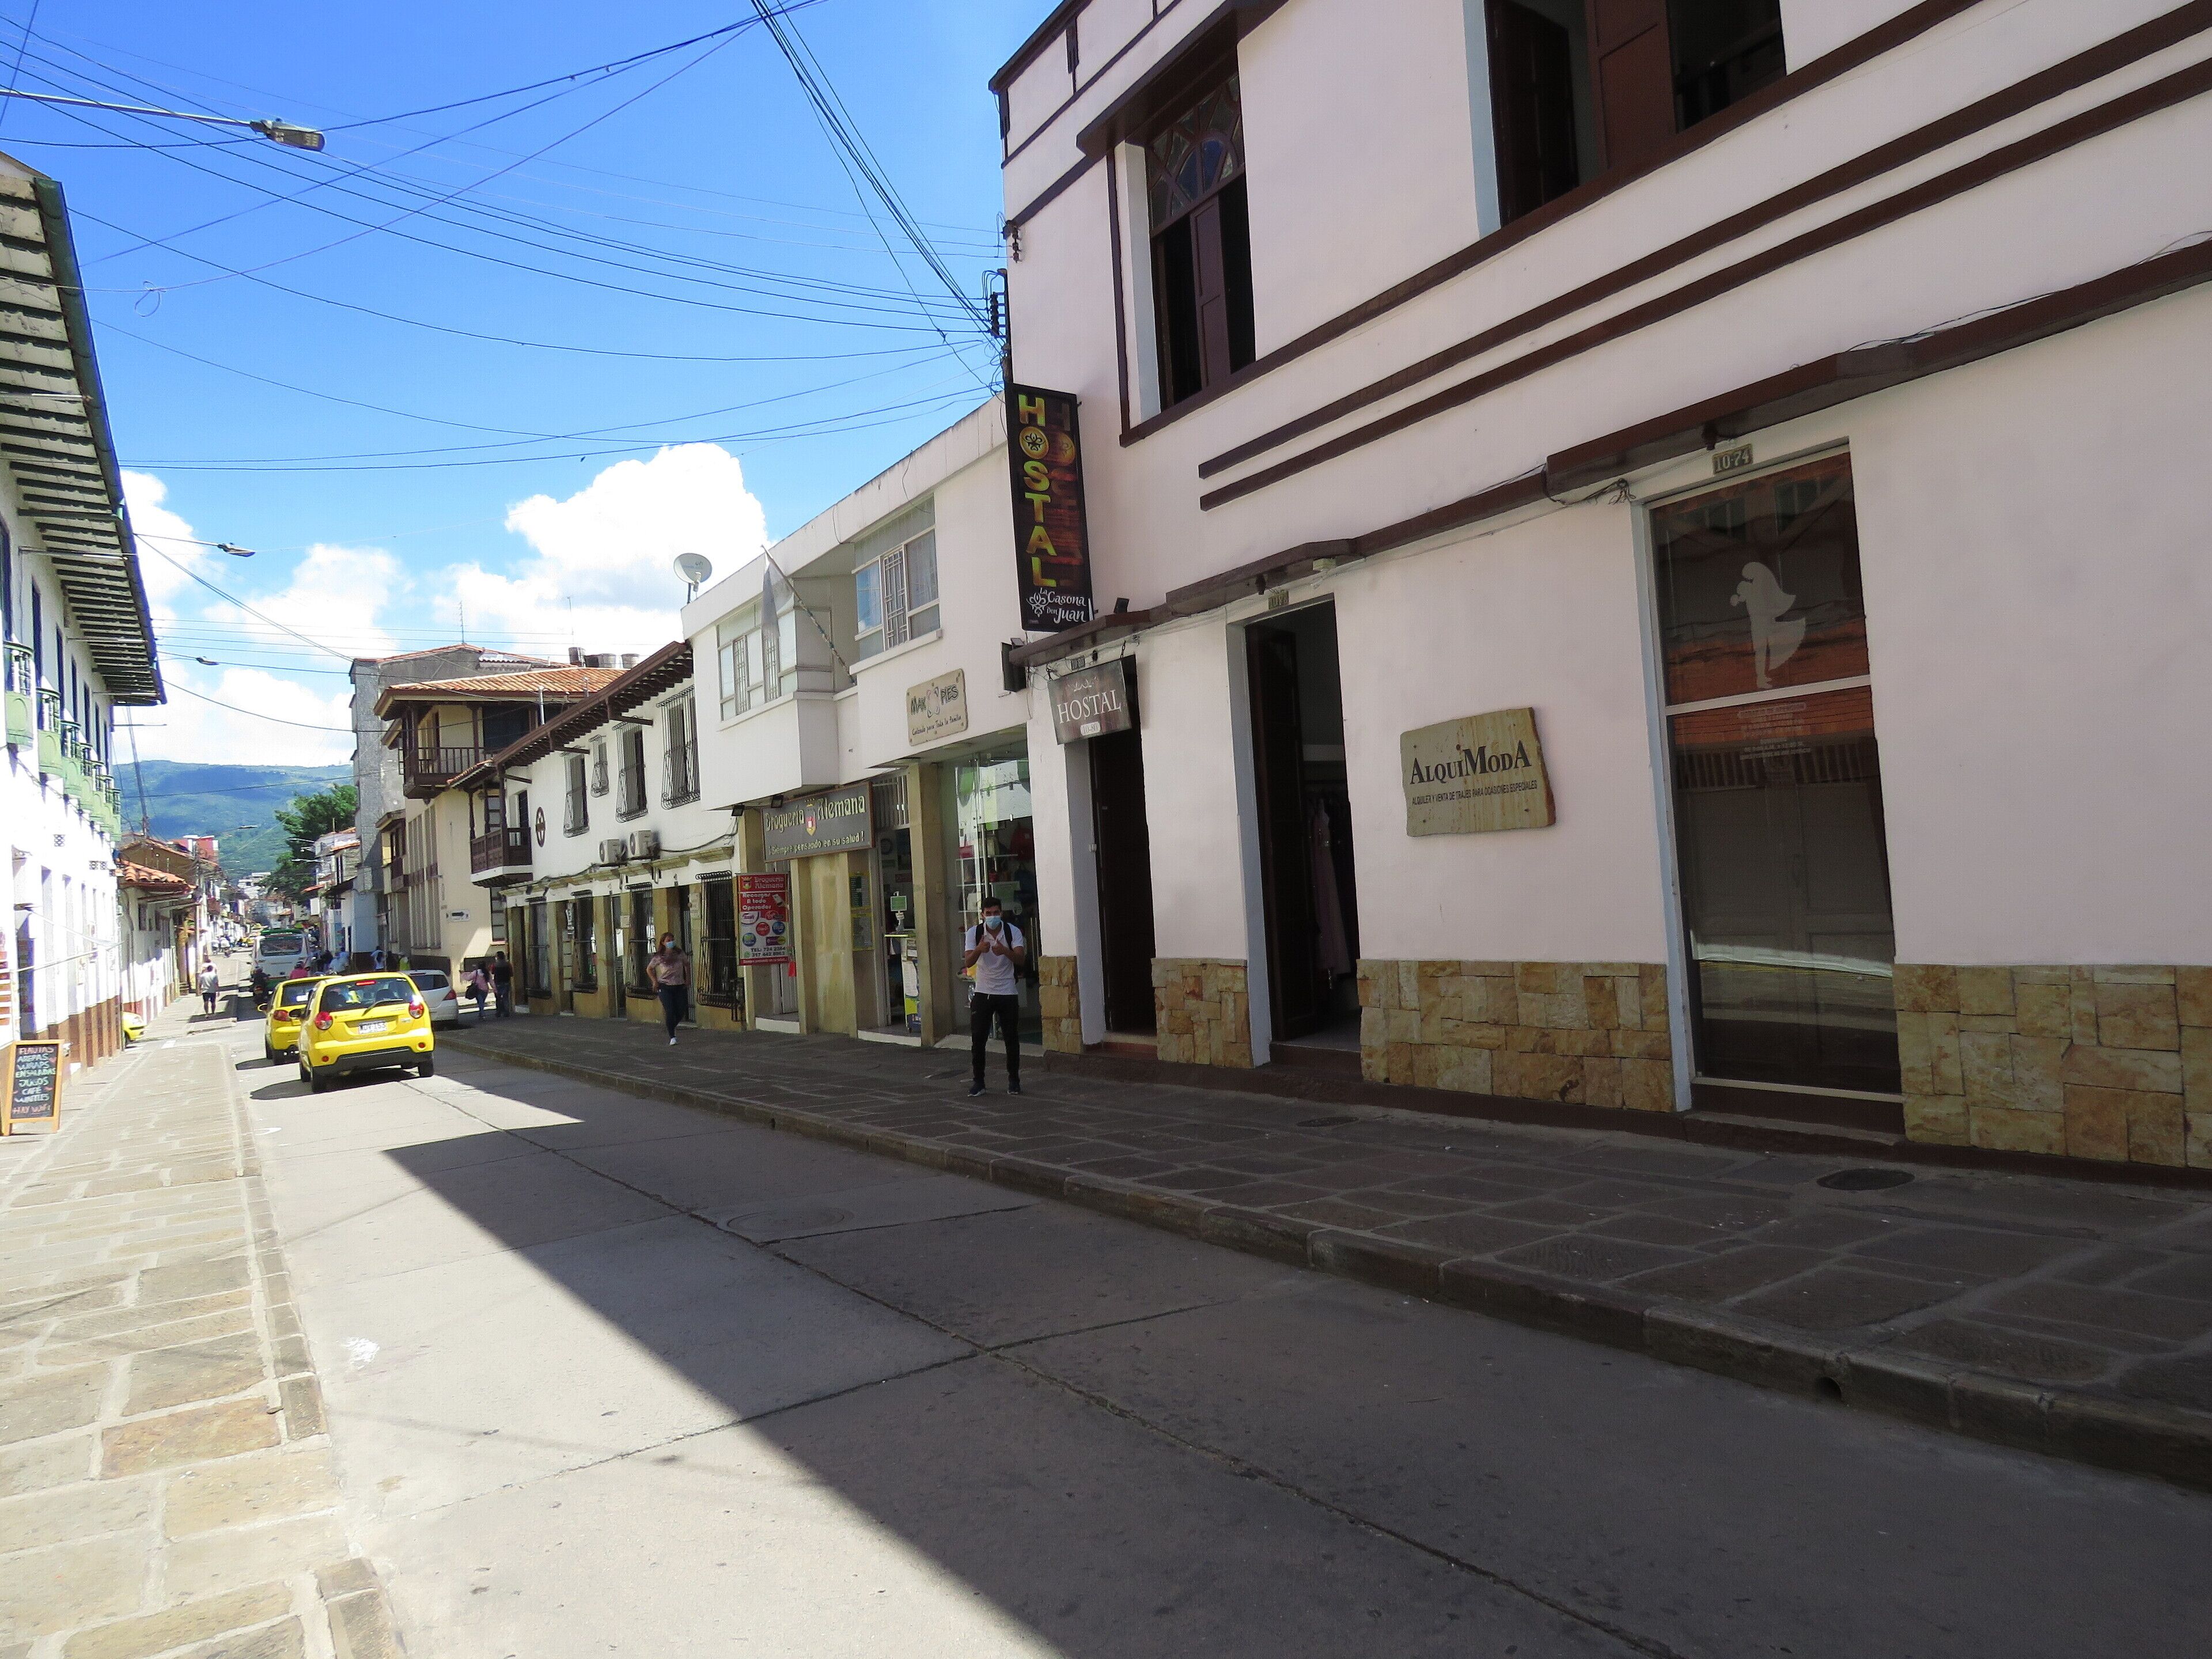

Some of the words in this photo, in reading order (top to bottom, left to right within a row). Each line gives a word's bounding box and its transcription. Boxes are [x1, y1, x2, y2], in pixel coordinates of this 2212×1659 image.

[1018, 394, 1057, 587] HOSTAL
[1040, 587, 1047, 595] La
[1047, 591, 1087, 607] Casona
[1047, 606, 1058, 615] Don
[1054, 608, 1087, 624] Juan
[911, 696, 927, 715] MAX
[940, 684, 959, 705] PIES
[1056, 690, 1122, 724] HOSTAL
[926, 725, 934, 734] para
[1412, 794, 1431, 805] ALQUILER
[1435, 793, 1449, 802] VENTA
[1449, 791, 1455, 801] DE
[1456, 789, 1471, 800] TRAJES
[1472, 787, 1483, 797] PARA
[1484, 784, 1509, 796] OCASIONES
[1510, 780, 1537, 793] ESPECIALES
[817, 796, 866, 820] Alemana
[794, 839, 822, 853] pensando
[823, 838, 831, 847] en
[832, 837, 840, 846] su
[17, 1053, 50, 1062] AREPAS
[15, 1067, 56, 1078] ENSALADAS
